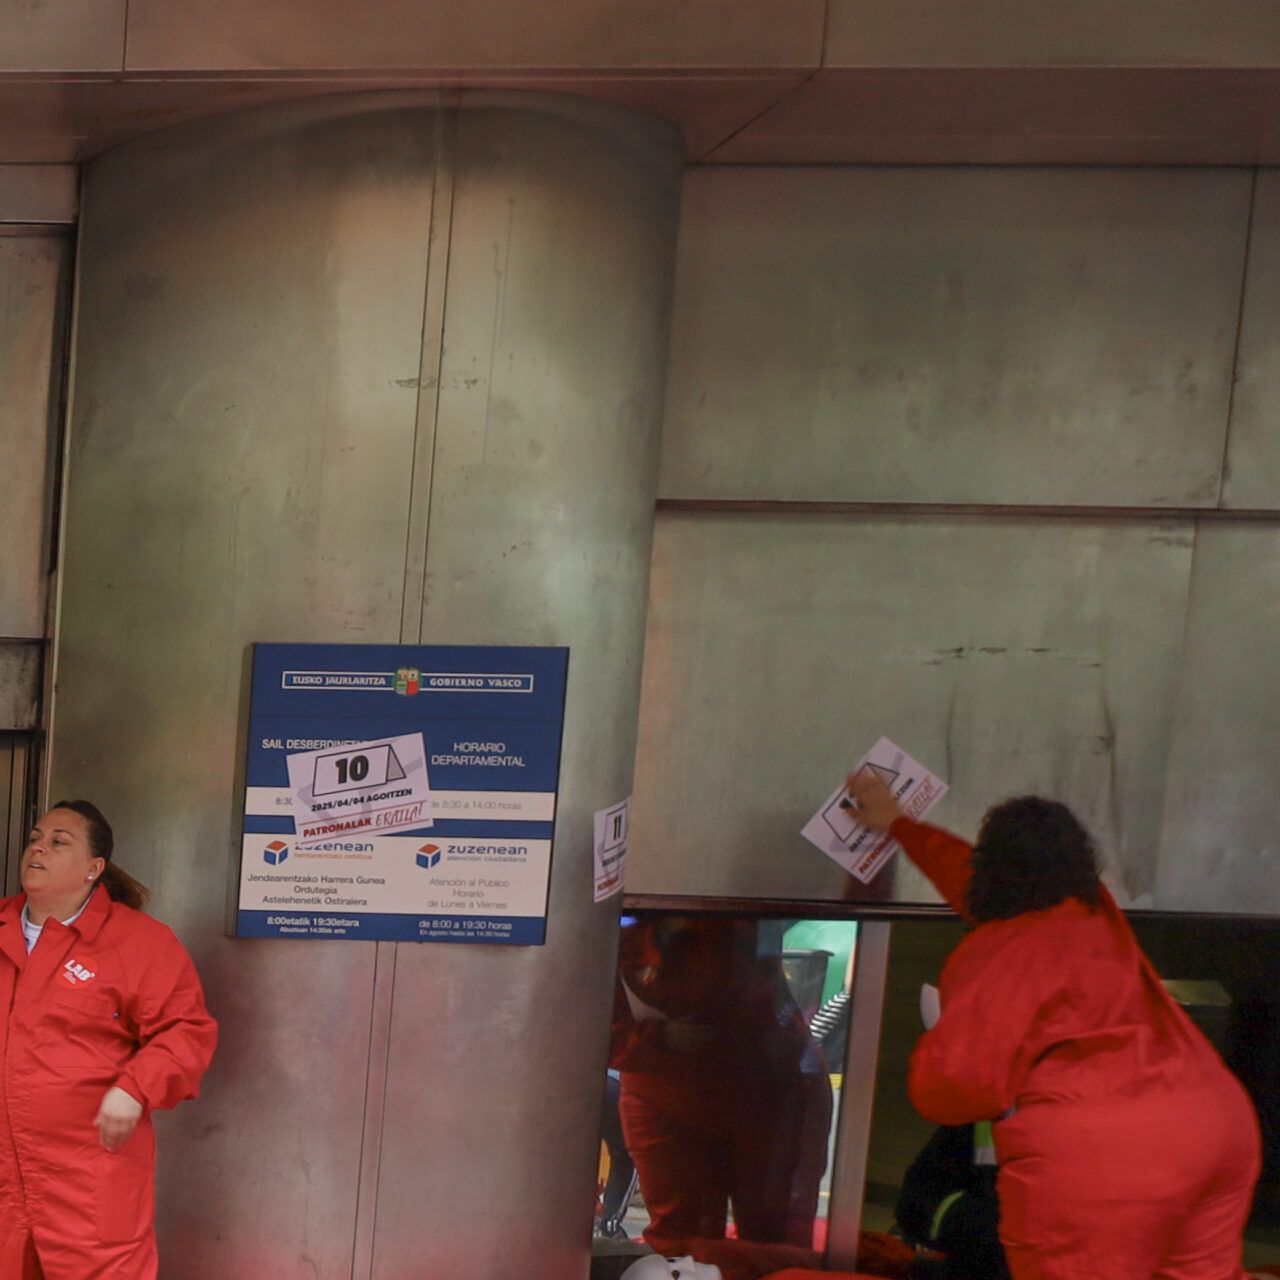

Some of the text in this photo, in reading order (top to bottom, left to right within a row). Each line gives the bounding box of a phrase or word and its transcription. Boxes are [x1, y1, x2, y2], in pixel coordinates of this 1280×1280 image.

[292, 675, 522, 688] EUSKO JAURLARITZA GOBIERNO VASCO
[262, 738, 284, 749] SAIL
[453, 741, 507, 753] HORARIO
[430, 754, 527, 768] DEPARTAMENTAL
[335, 755, 370, 784] 10
[366, 788, 414, 803] AGOITZEN
[303, 817, 372, 838] PATRONALAK
[447, 844, 528, 856] zuzenean
[247, 873, 386, 886] Jendearentzako Harrera Gunea
[293, 884, 339, 897] Ordutegia
[452, 888, 485, 899] Horario
[427, 899, 439, 909] de
[440, 899, 466, 909] Lunes
[418, 919, 431, 930] de
[487, 920, 513, 931] horas
